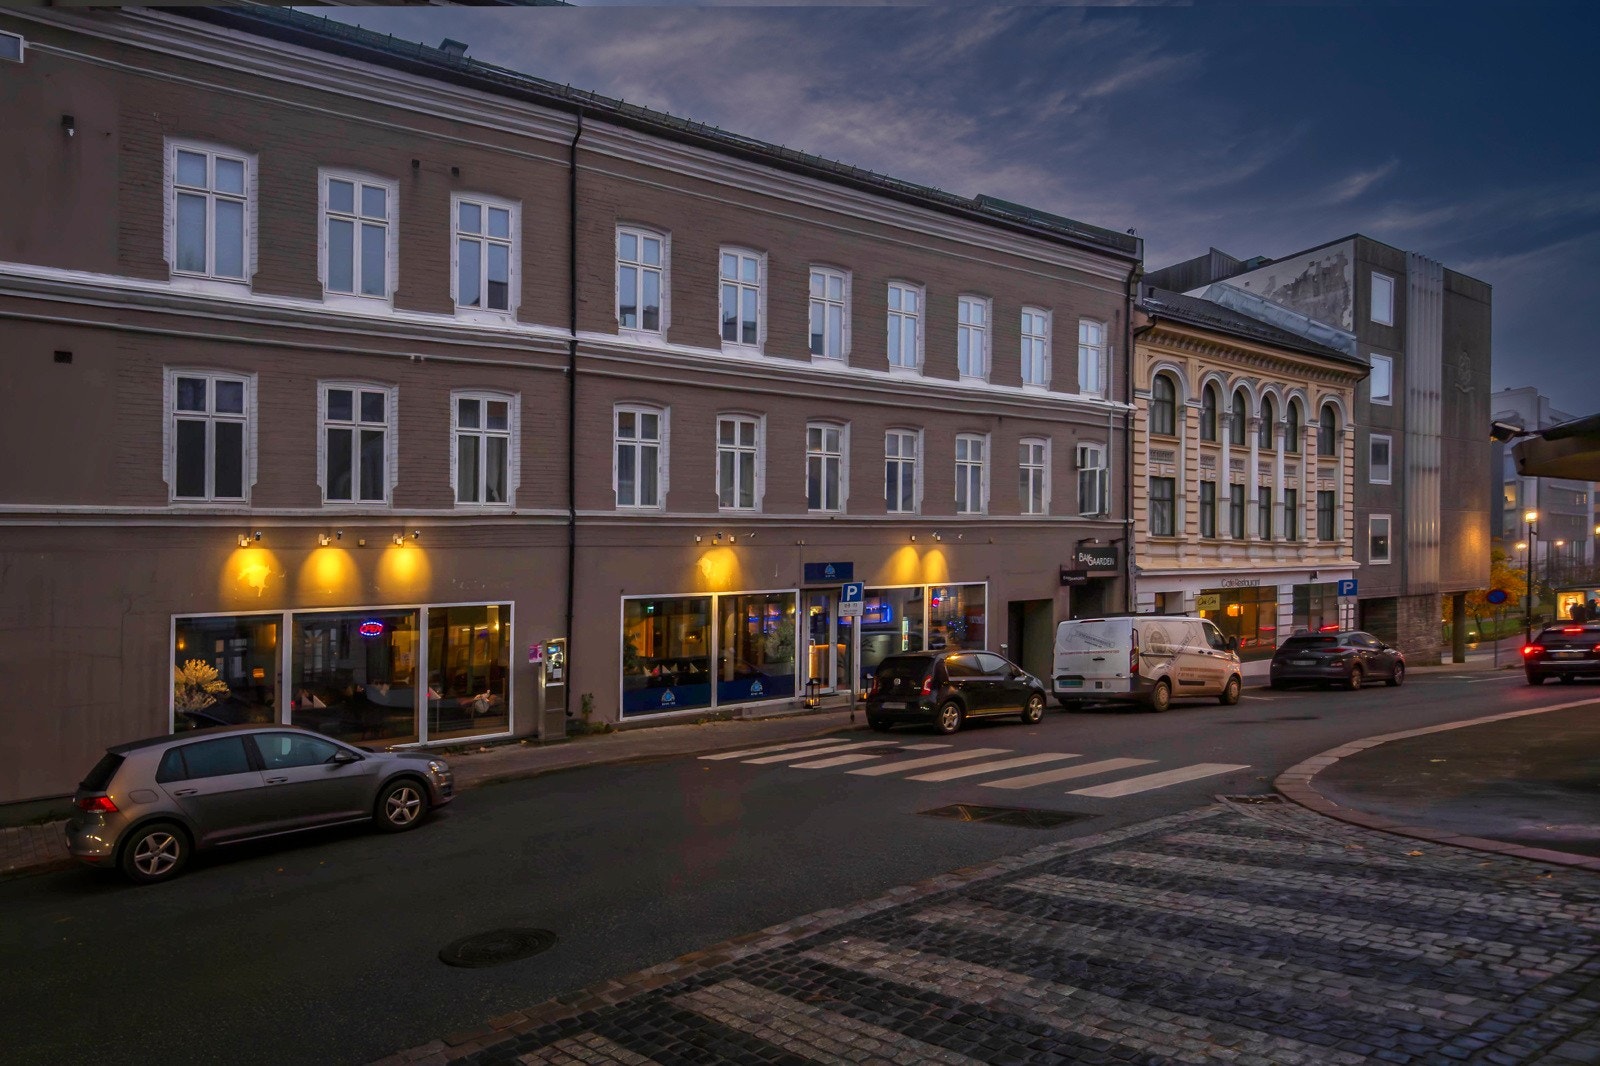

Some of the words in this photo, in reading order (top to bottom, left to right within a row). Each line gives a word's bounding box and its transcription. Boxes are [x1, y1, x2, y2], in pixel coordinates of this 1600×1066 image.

[847, 586, 857, 601] P
[1343, 581, 1354, 594] P
[359, 625, 382, 633] OPEN
